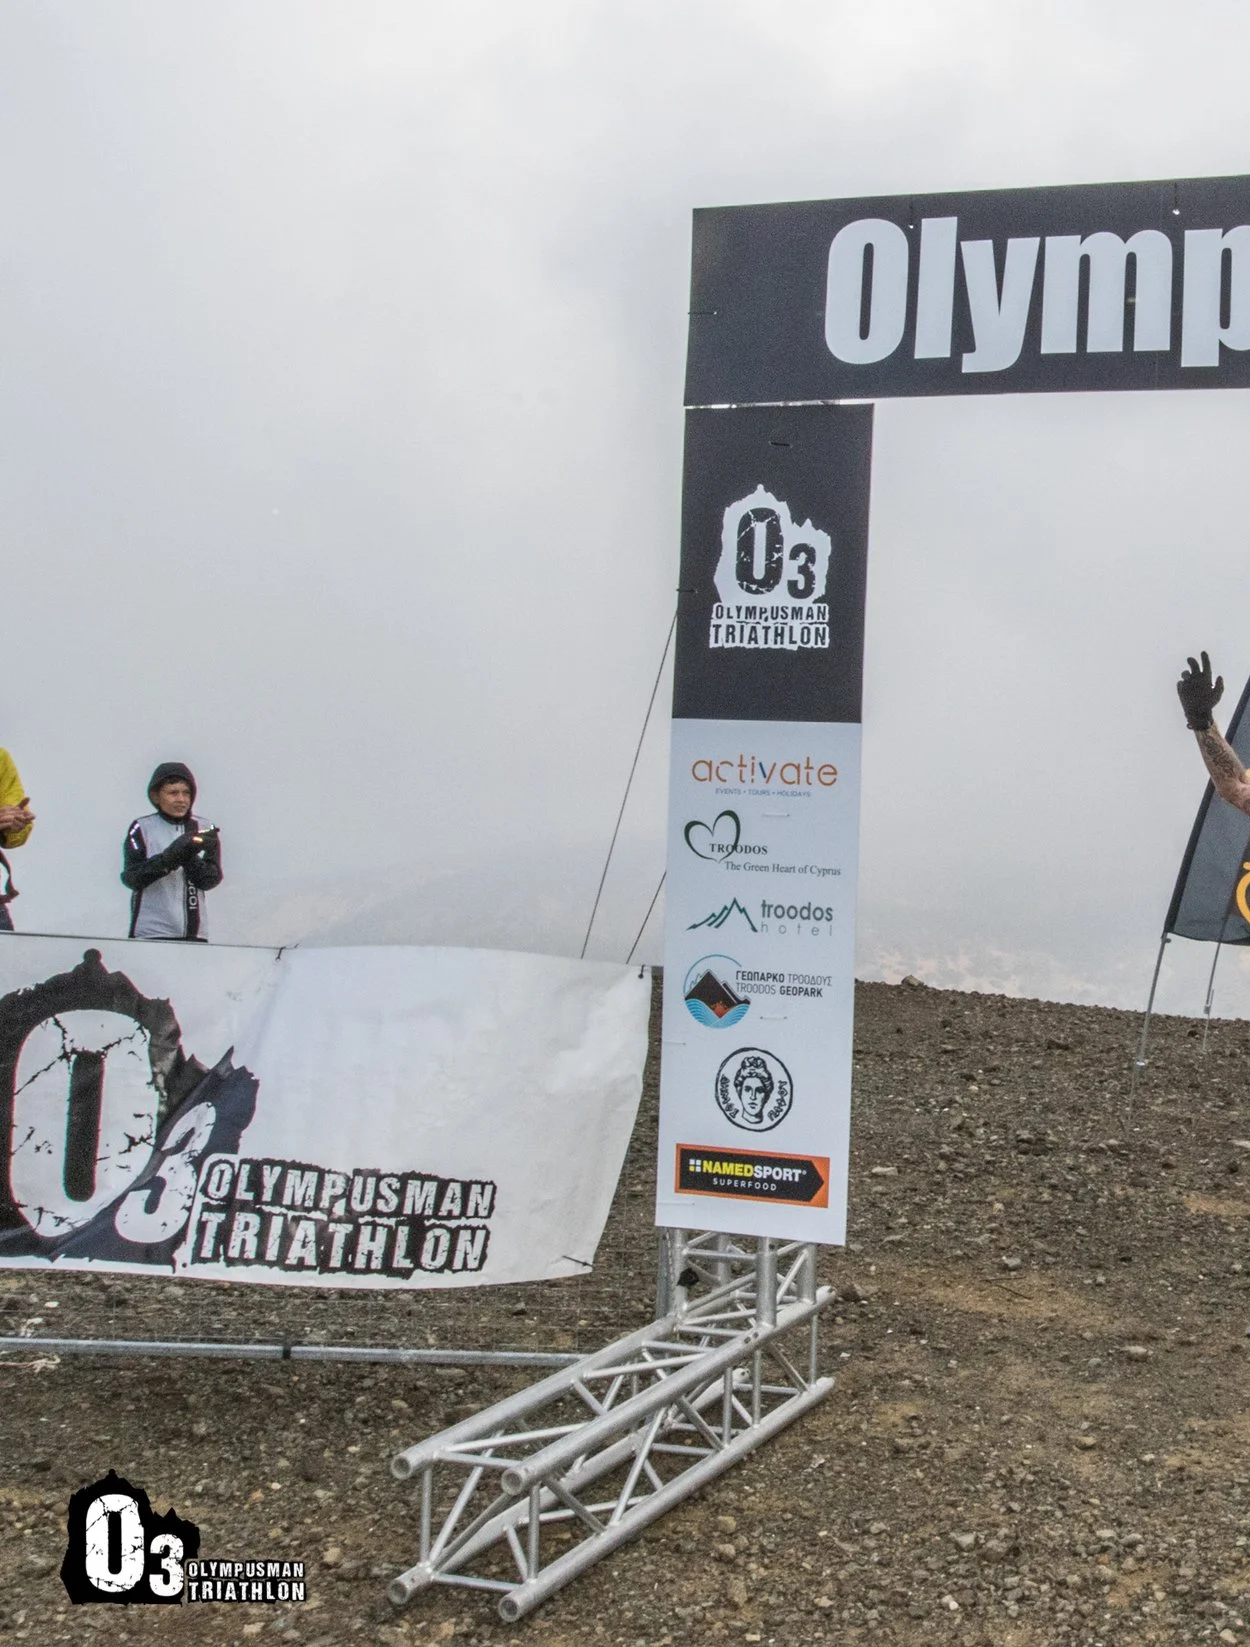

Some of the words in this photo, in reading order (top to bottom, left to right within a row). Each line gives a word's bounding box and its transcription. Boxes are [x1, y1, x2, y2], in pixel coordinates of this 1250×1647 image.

[715, 604, 827, 622] OLYMPUSMAN
[712, 624, 828, 645] TRIATHLON
[691, 754, 838, 787] activate
[748, 788, 770, 796] TOURS
[777, 789, 811, 797] HOLIDAYS
[709, 843, 768, 855] TROODOS
[725, 861, 741, 871] The
[743, 861, 770, 873] Green
[772, 863, 796, 874] Heart
[797, 864, 809, 875] of
[809, 865, 841, 877] Cyprus
[760, 900, 833, 922] troodos
[760, 922, 833, 936] hotel
[736, 982, 777, 995] TROODOS
[779, 986, 823, 998] GEOPARK
[205, 1159, 497, 1219] OLYMPUSMAN
[712, 1177, 777, 1191] SUPERFOOD
[201, 1211, 489, 1273] TRIATHLON
